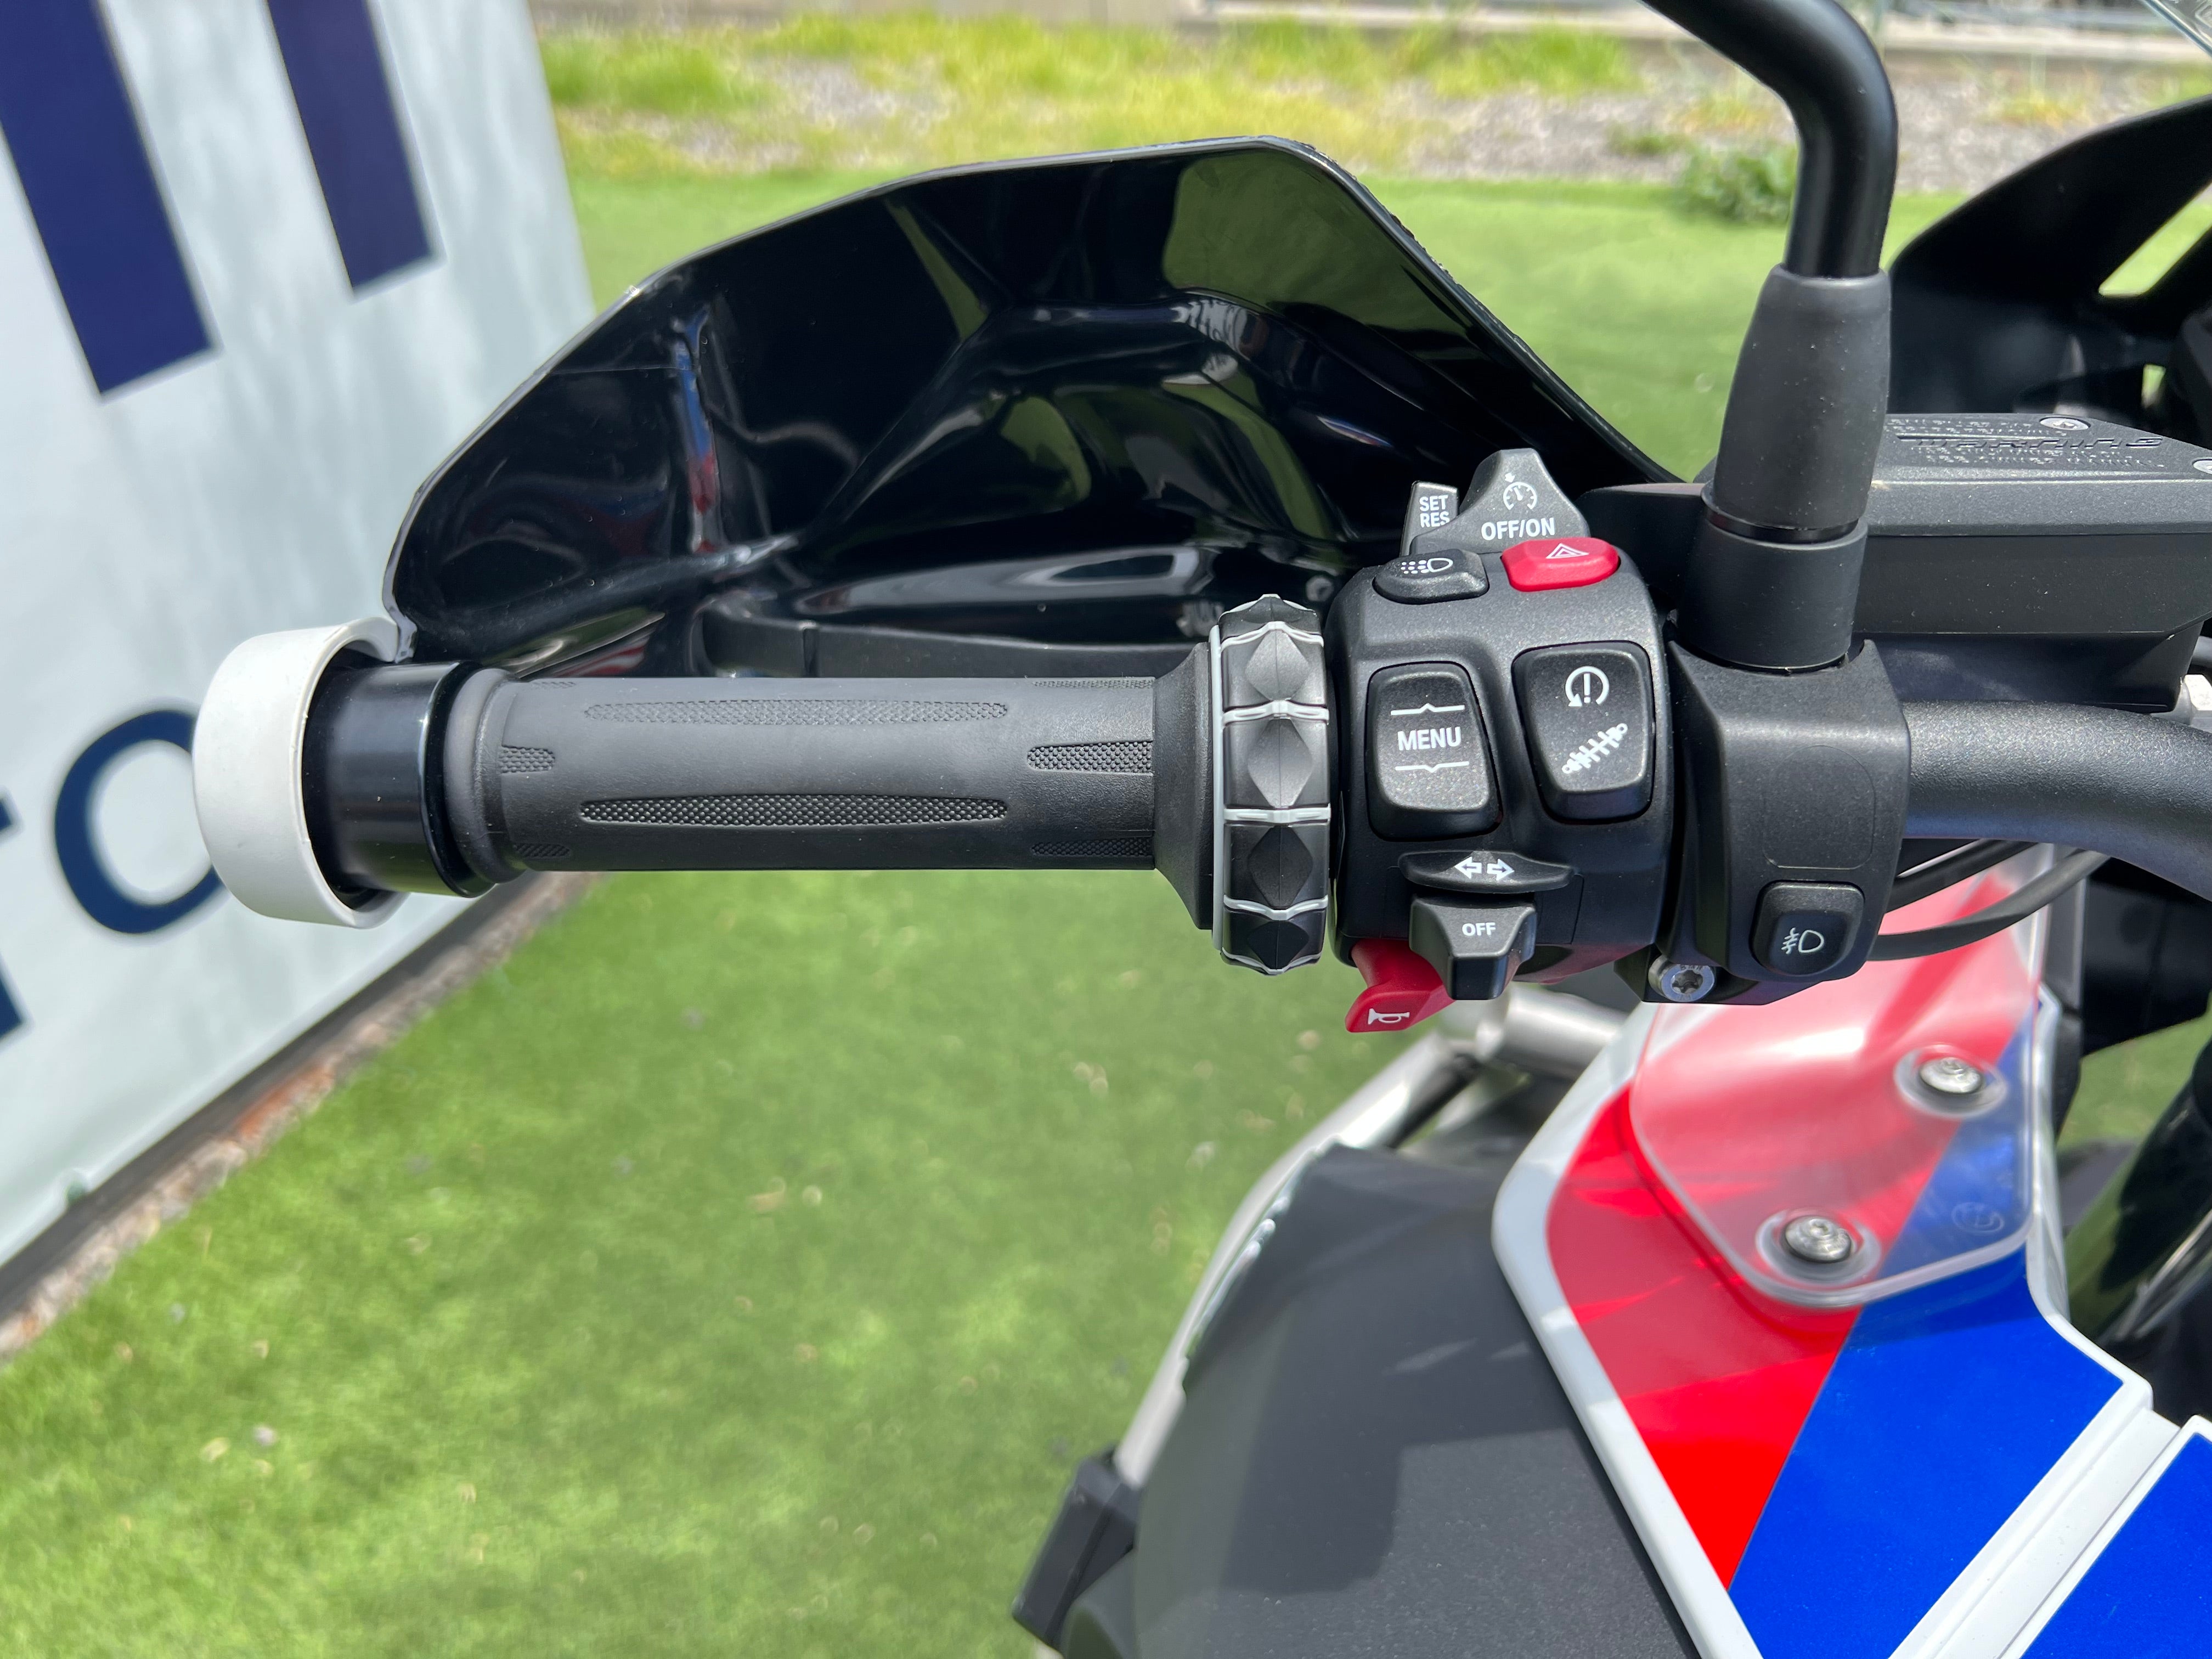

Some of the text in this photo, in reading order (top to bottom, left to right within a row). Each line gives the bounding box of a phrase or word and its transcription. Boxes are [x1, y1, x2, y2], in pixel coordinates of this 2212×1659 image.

[1419, 495, 1448, 511] SET
[1420, 511, 1450, 528] RES
[1481, 517, 1555, 540] OFF/ON
[1397, 726, 1462, 751] MENU
[1462, 922, 1496, 936] OFF
